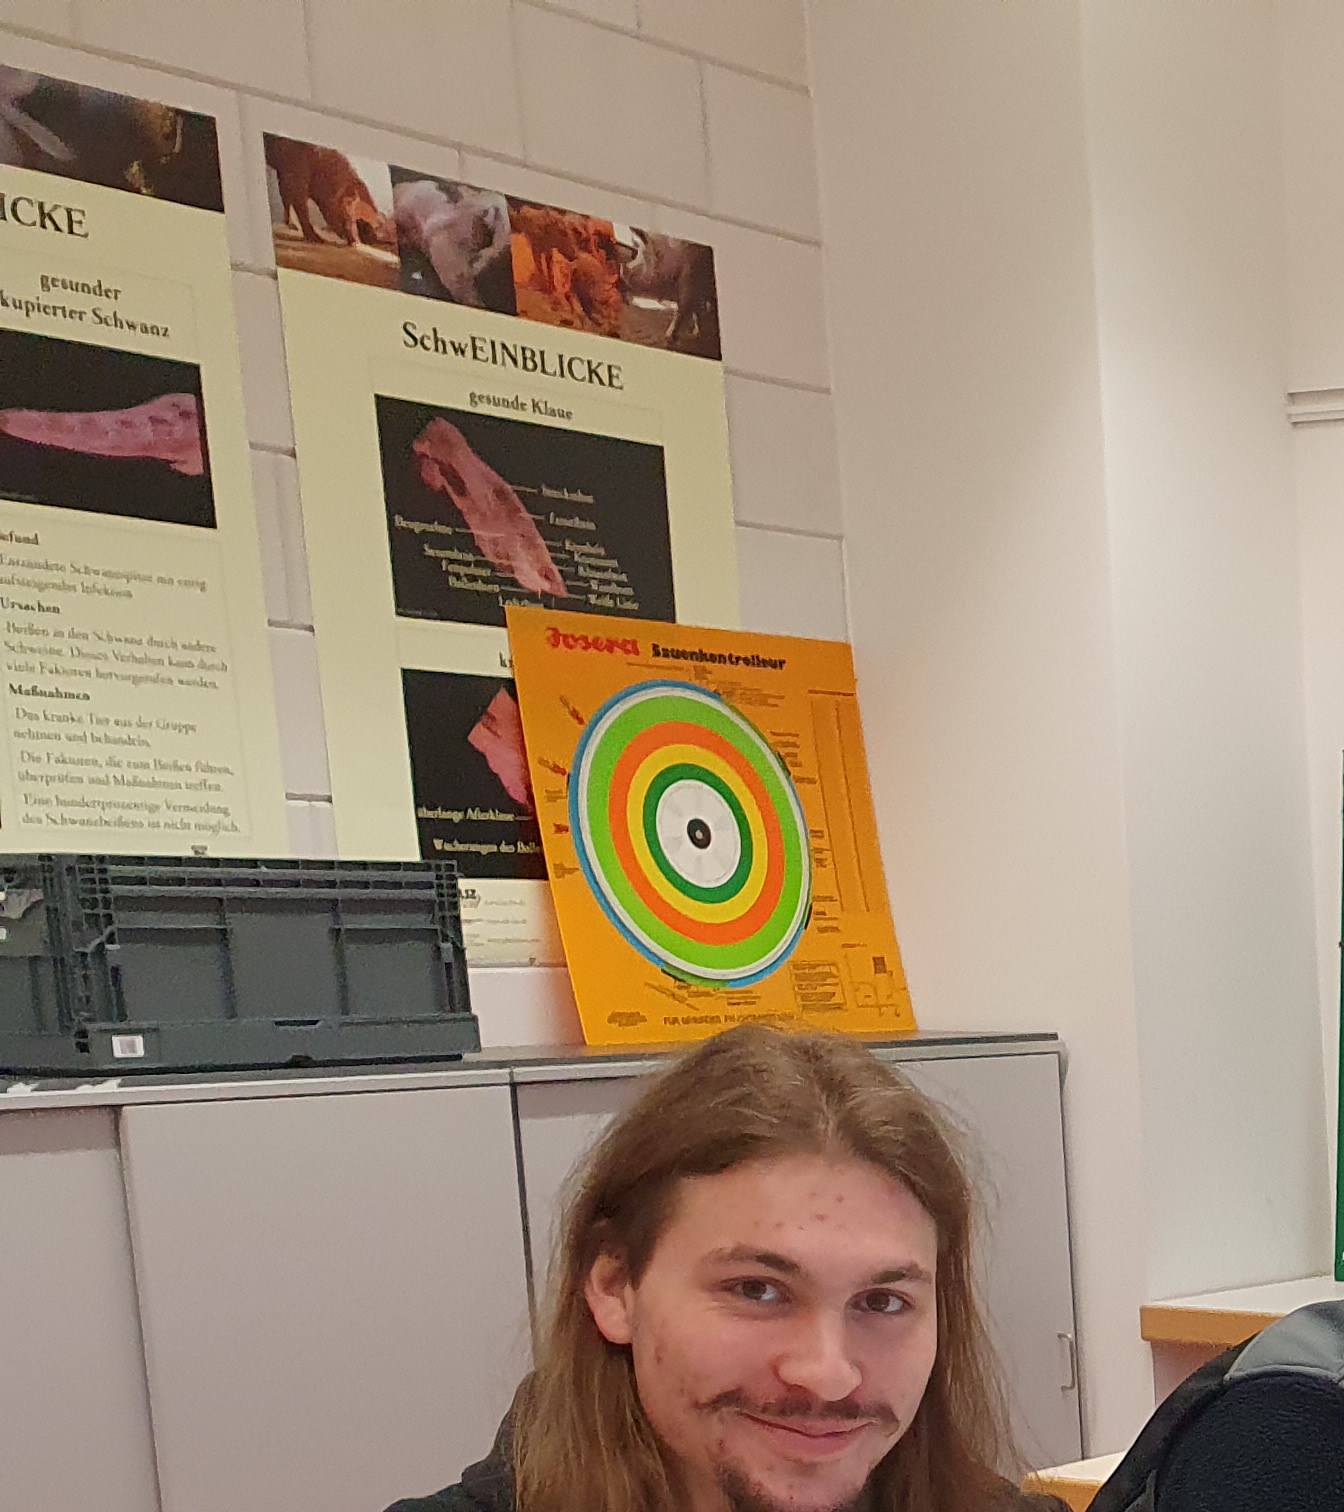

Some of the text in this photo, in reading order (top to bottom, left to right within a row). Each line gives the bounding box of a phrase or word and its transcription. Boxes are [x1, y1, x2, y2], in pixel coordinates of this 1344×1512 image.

[40, 274, 122, 301] gesunder
[92, 307, 170, 338] Schwanz
[401, 321, 624, 390] SchwEINBLICKE
[469, 390, 573, 421] gesunde Klaue
[651, 643, 786, 671] Sauenkontrolleur
[8, 683, 91, 701] Maßnahmen
